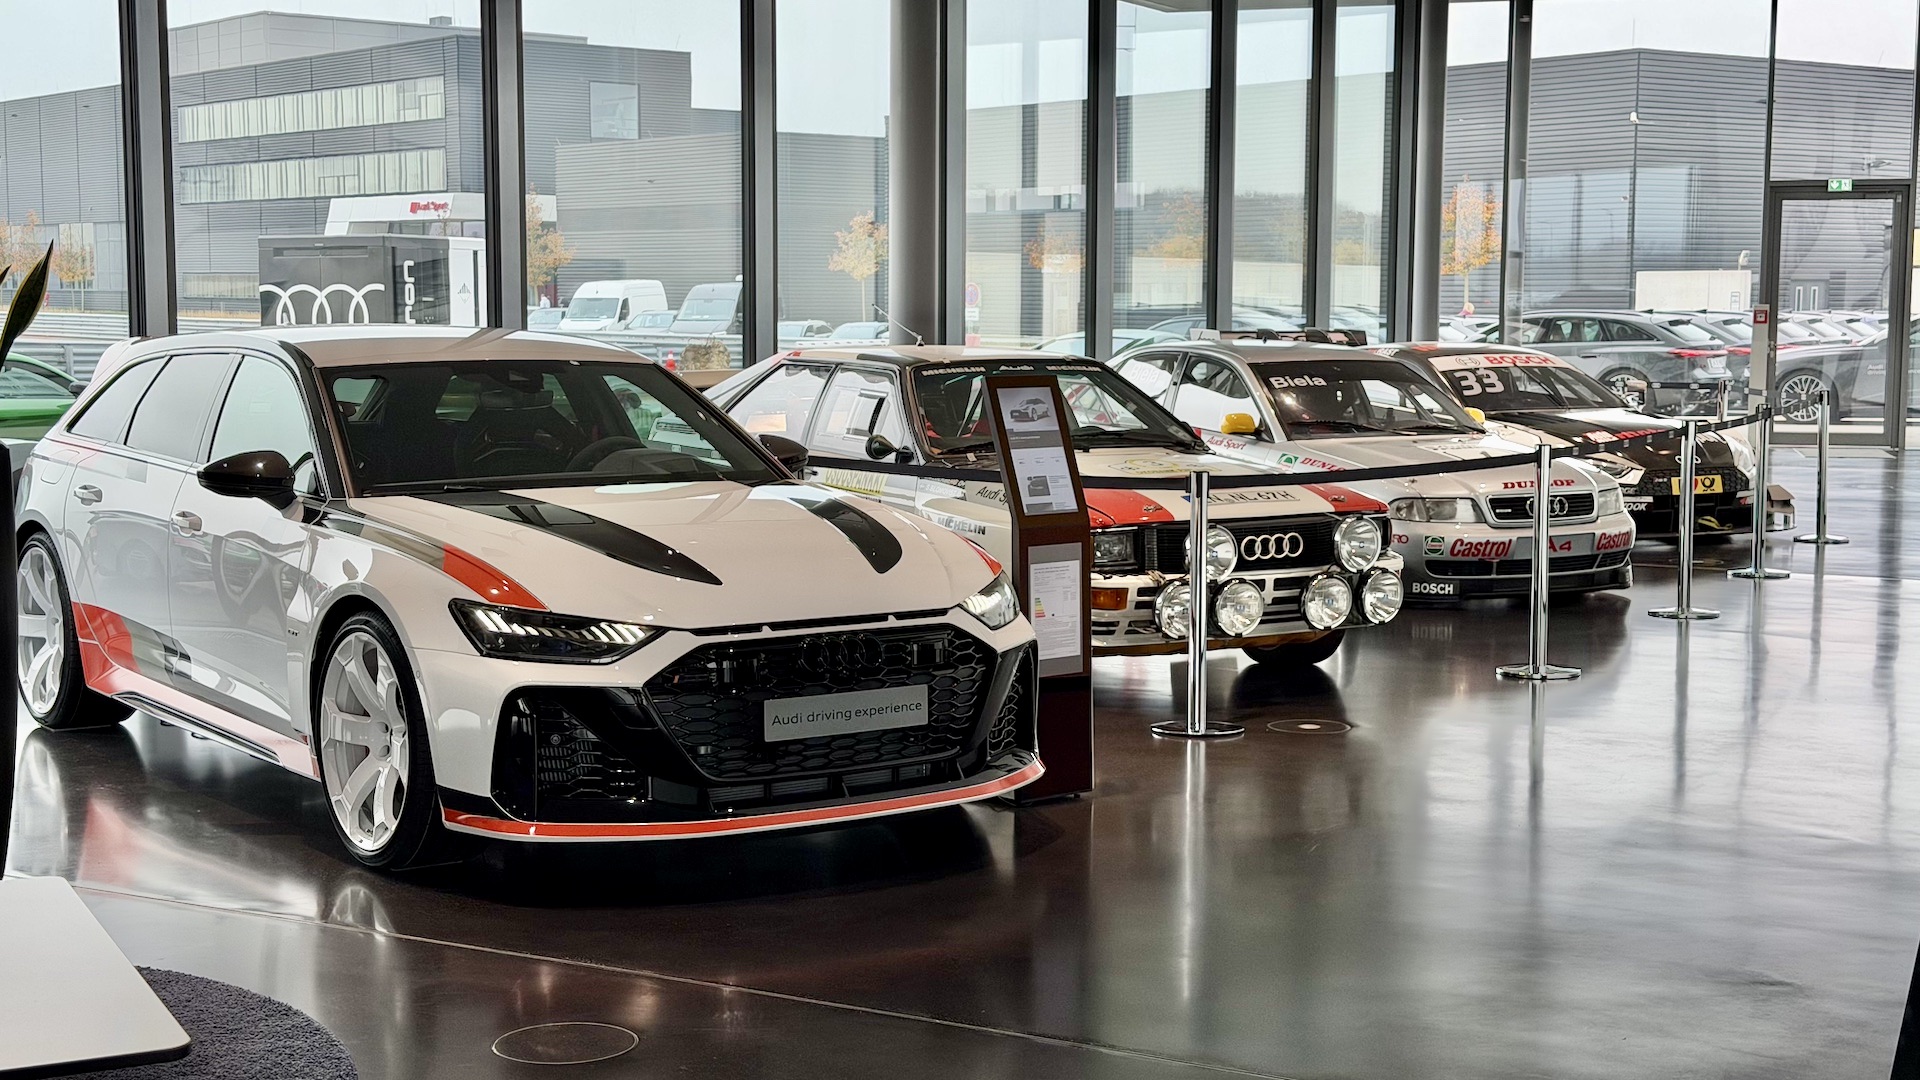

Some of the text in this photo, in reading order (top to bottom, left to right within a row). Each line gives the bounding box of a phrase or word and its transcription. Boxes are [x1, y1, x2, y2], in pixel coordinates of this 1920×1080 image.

[1484, 356, 1556, 365] BOSCH
[921, 366, 987, 377] MICHELIN
[1045, 365, 1102, 373] MICHELIN
[1268, 375, 1327, 389] Biela
[1453, 368, 1505, 396] 33
[1207, 435, 1247, 450] Audi Sport
[1300, 457, 1346, 472] DUNL
[1502, 479, 1575, 489] DUOP
[976, 486, 1001, 500] Audi
[937, 517, 986, 535] MICHELIN
[1596, 528, 1632, 550] Castrol
[1450, 538, 1512, 558] Castrol
[1412, 582, 1453, 595] BOSCH
[771, 701, 923, 727] Audi driving experience
